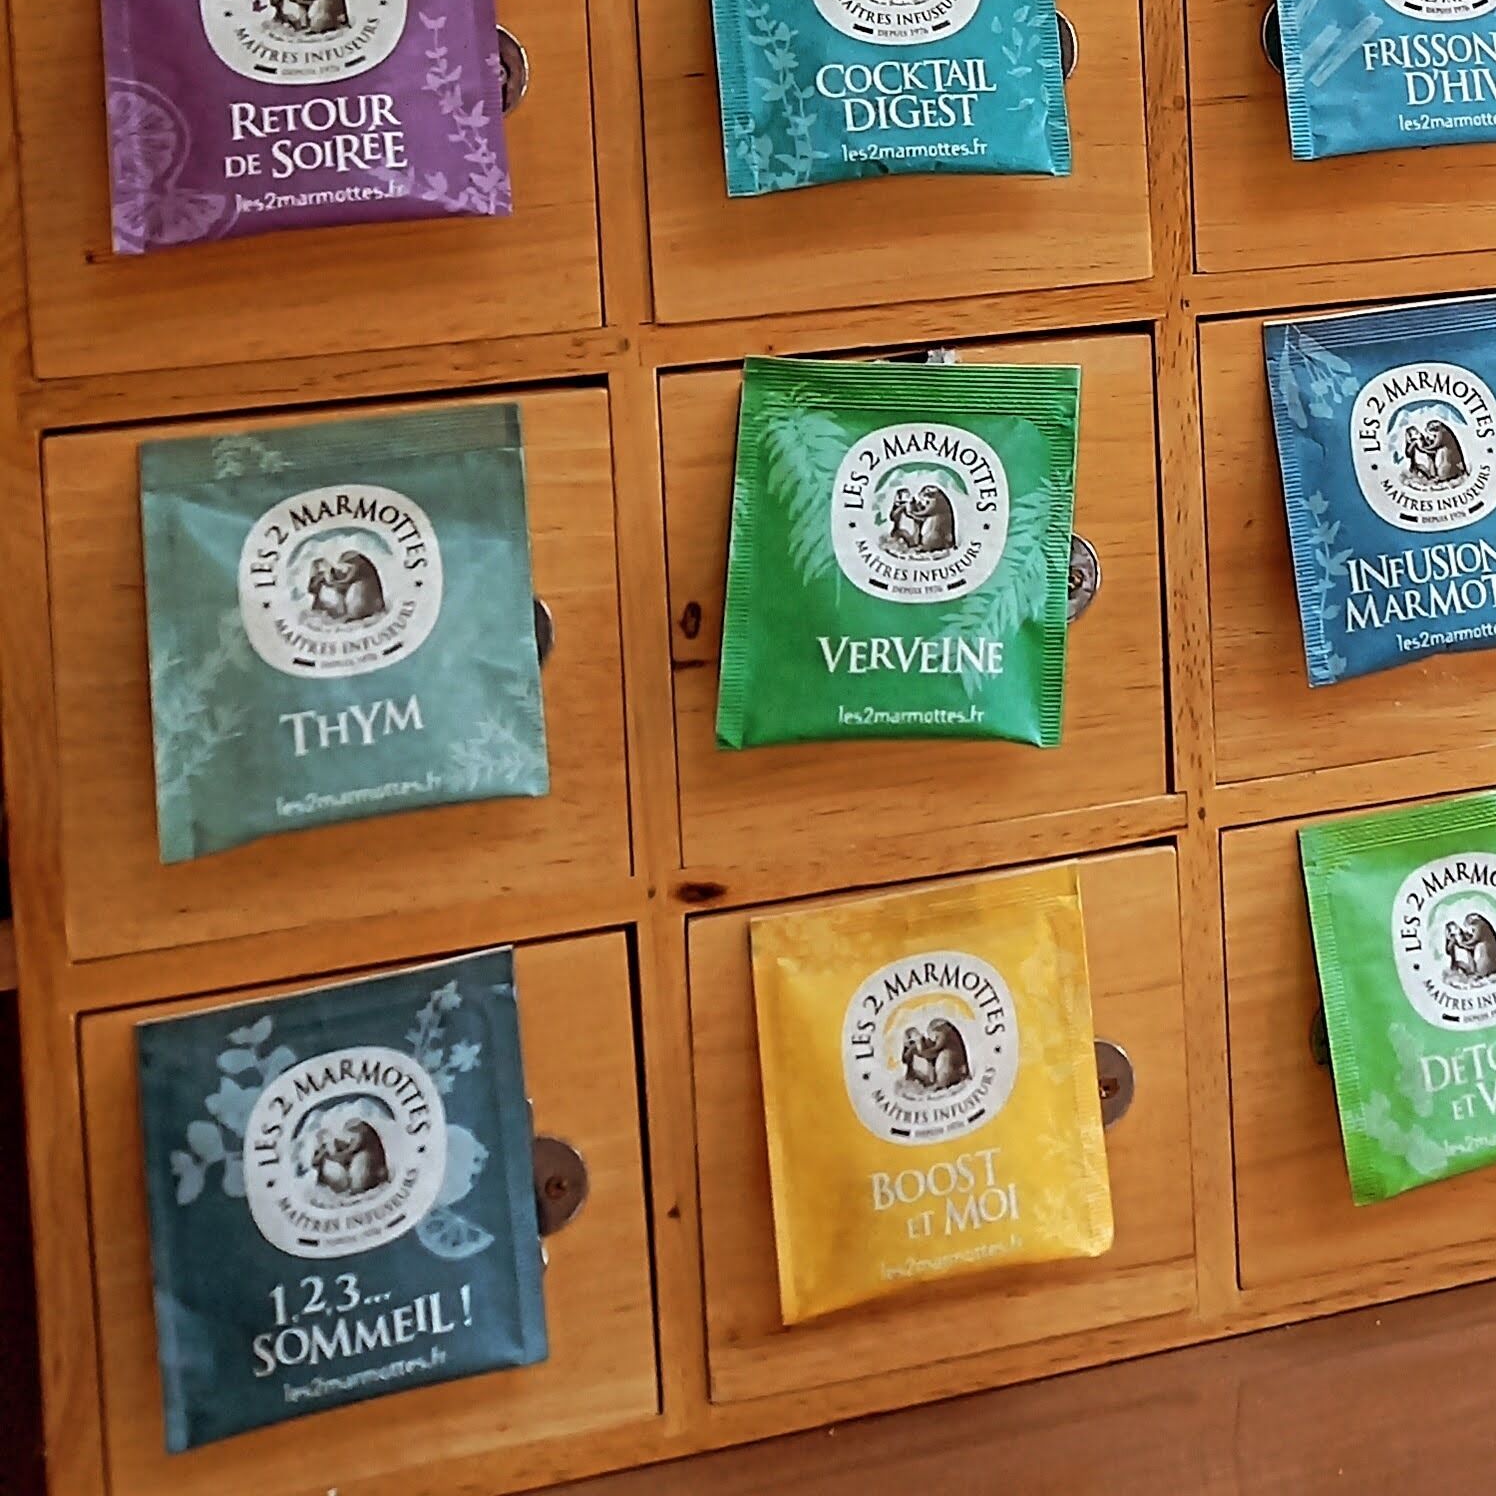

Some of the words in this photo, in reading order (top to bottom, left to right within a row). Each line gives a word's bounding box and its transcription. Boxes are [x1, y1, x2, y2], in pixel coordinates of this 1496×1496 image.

[816, 59, 997, 98] COCKTAIL
[230, 94, 401, 140] RETOUR
[842, 94, 978, 132] DIGEST
[225, 154, 262, 178] DE
[272, 124, 407, 178] SOIRÉE
[842, 138, 987, 162] les2marmottes.fr
[236, 179, 408, 212] les2marmottes.fr
[1367, 397, 1385, 414] 2
[1383, 371, 1495, 439] MARMOTTES
[1360, 417, 1381, 452] LES
[843, 471, 870, 509] LES
[860, 451, 880, 470] 2
[883, 432, 997, 512] MARMOTTES
[1438, 464, 1491, 510] INFUSEURS
[265, 526, 289, 545] 2
[289, 495, 428, 571] MARMOTTES
[251, 549, 280, 588] LES
[913, 541, 981, 582] INFUSEURS
[816, 636, 1004, 674] VERVEINE
[279, 694, 425, 756] THYM
[839, 705, 984, 724] les2marmottes.fr
[1407, 893, 1424, 911] 2
[1401, 915, 1422, 952] LES
[851, 1020, 876, 1060] LES
[864, 995, 884, 1015] 2
[884, 962, 1005, 1036] MARMOTTES
[255, 1124, 282, 1167] LES
[269, 1096, 293, 1116] 2
[294, 1059, 431, 1135] MARMOTTES
[1452, 1094, 1476, 1120] ET
[870, 1148, 1000, 1211] BOOST
[907, 1210, 935, 1239] ET
[945, 1183, 1020, 1235] MOI
[253, 1292, 455, 1377] SOMMEIL
[461, 1284, 472, 1327] !
